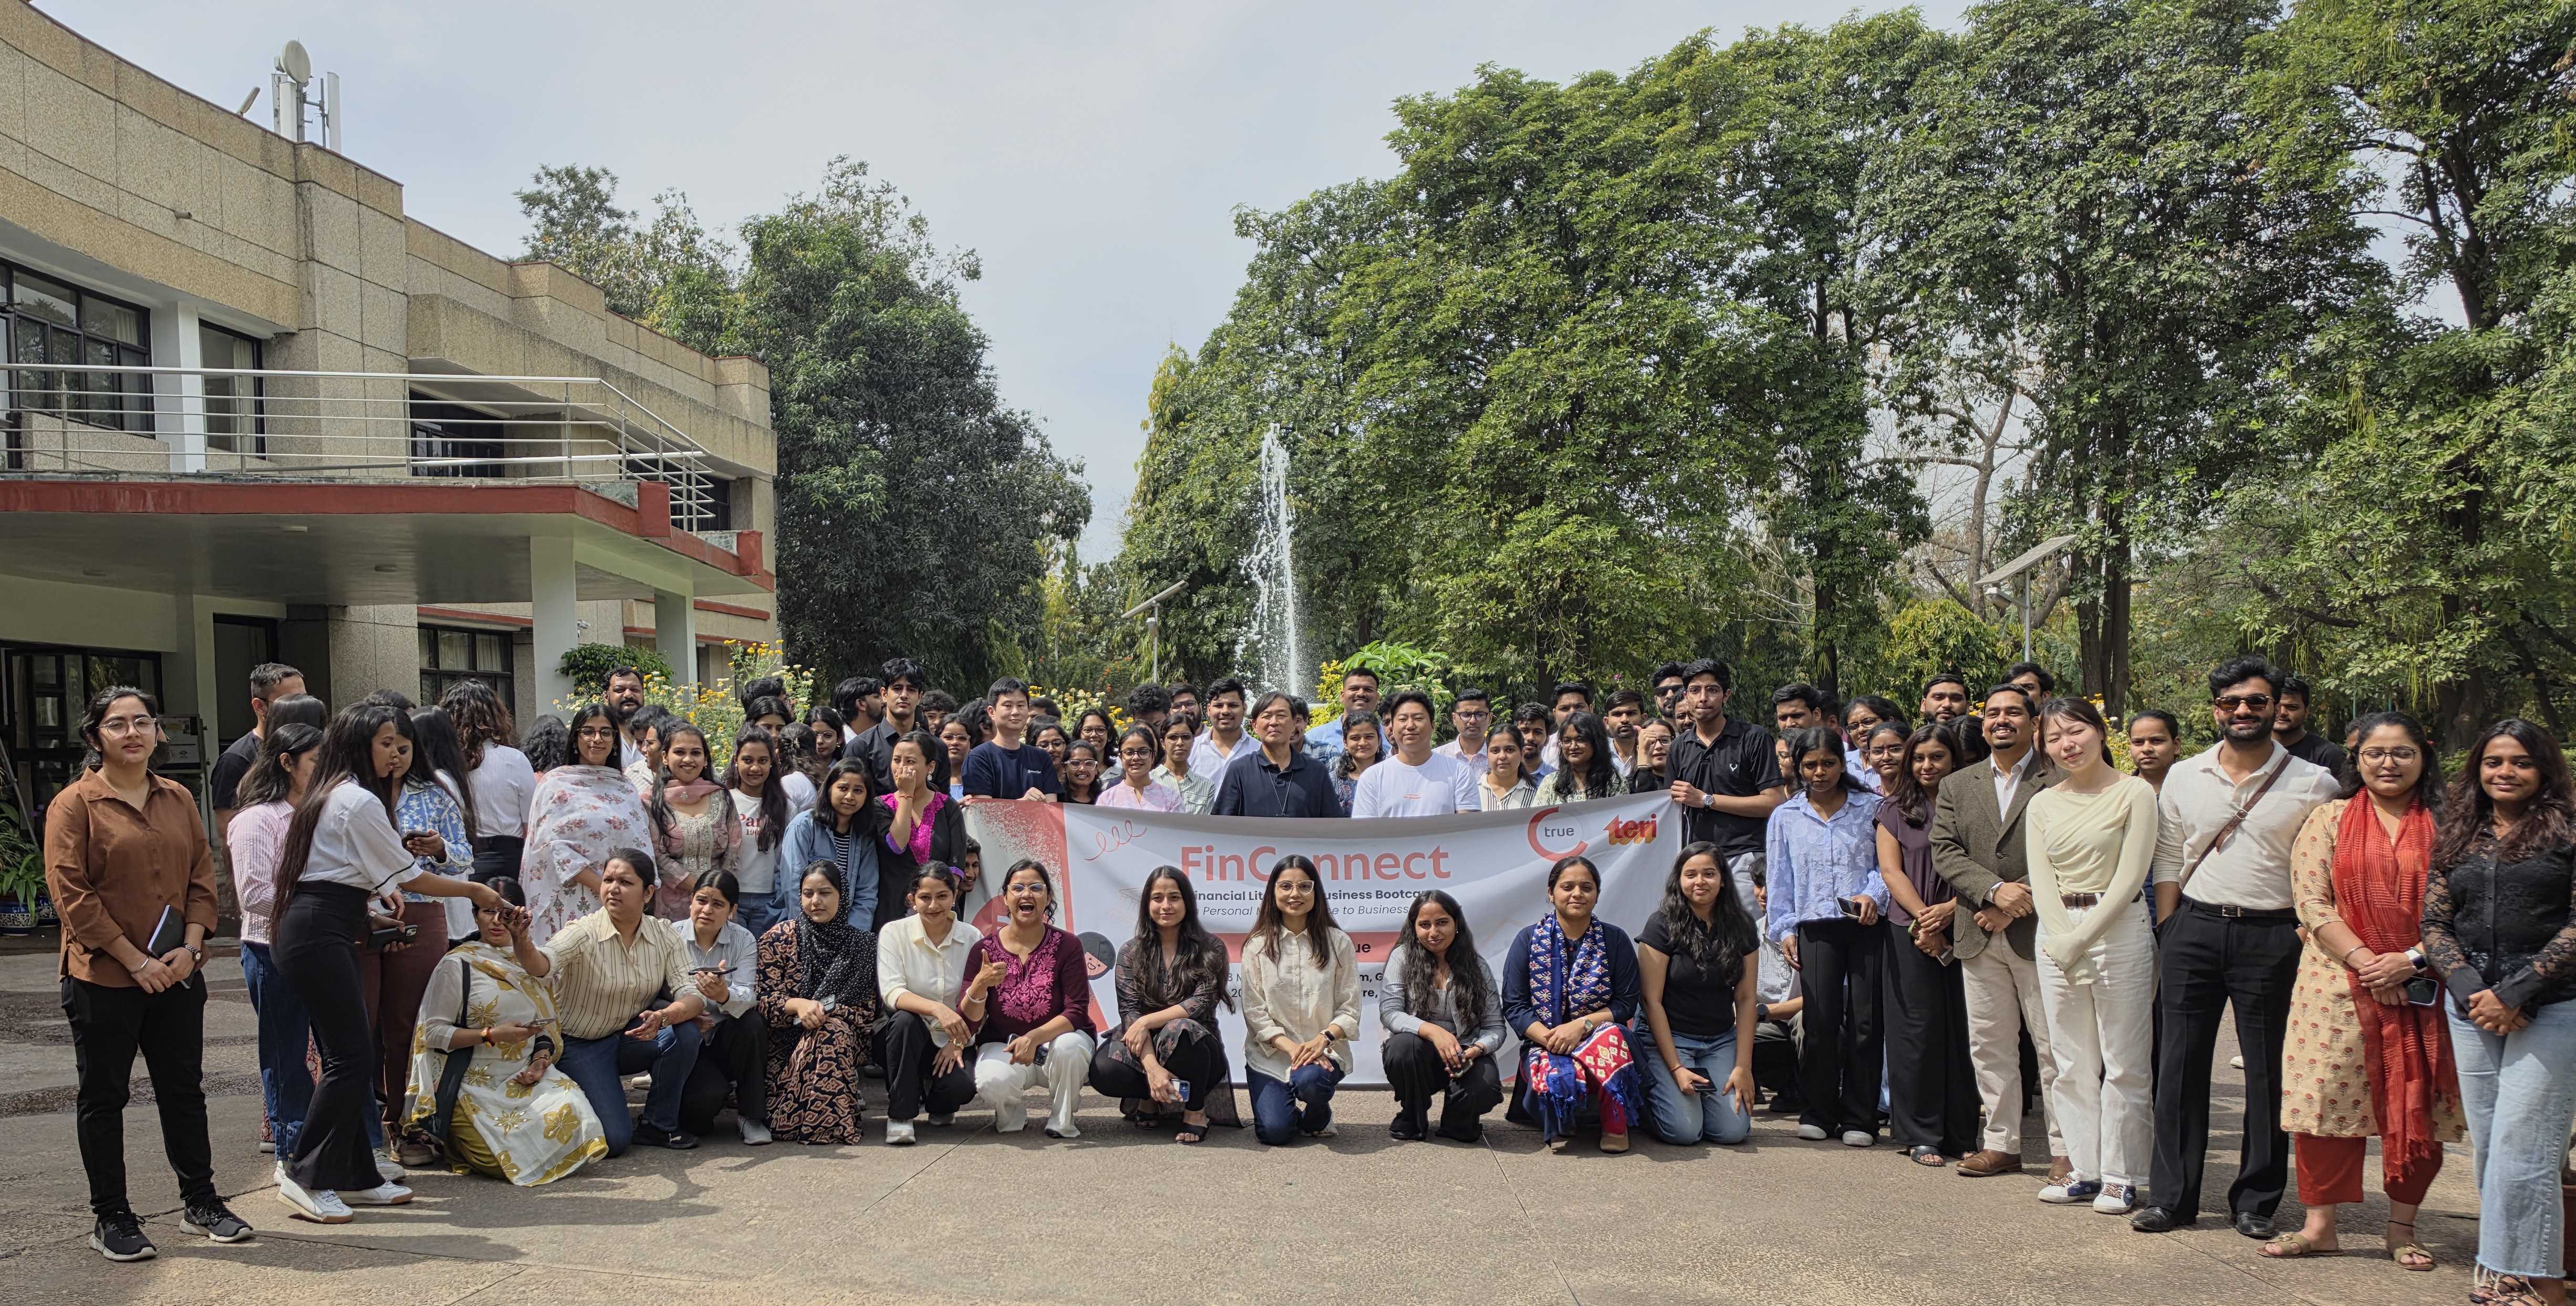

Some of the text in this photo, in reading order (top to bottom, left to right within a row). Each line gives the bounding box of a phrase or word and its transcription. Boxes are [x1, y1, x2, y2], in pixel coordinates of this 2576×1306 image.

[1544, 827, 1574, 837] true
[1604, 813, 1657, 845] teri
[1181, 845, 1451, 881] FinCnnect
[1194, 891, 1245, 901] inancial
[1327, 890, 1372, 900] usiness
[1375, 890, 1421, 900] Bootca
[1203, 906, 1252, 915] Personal
[1358, 905, 1409, 915] Business
